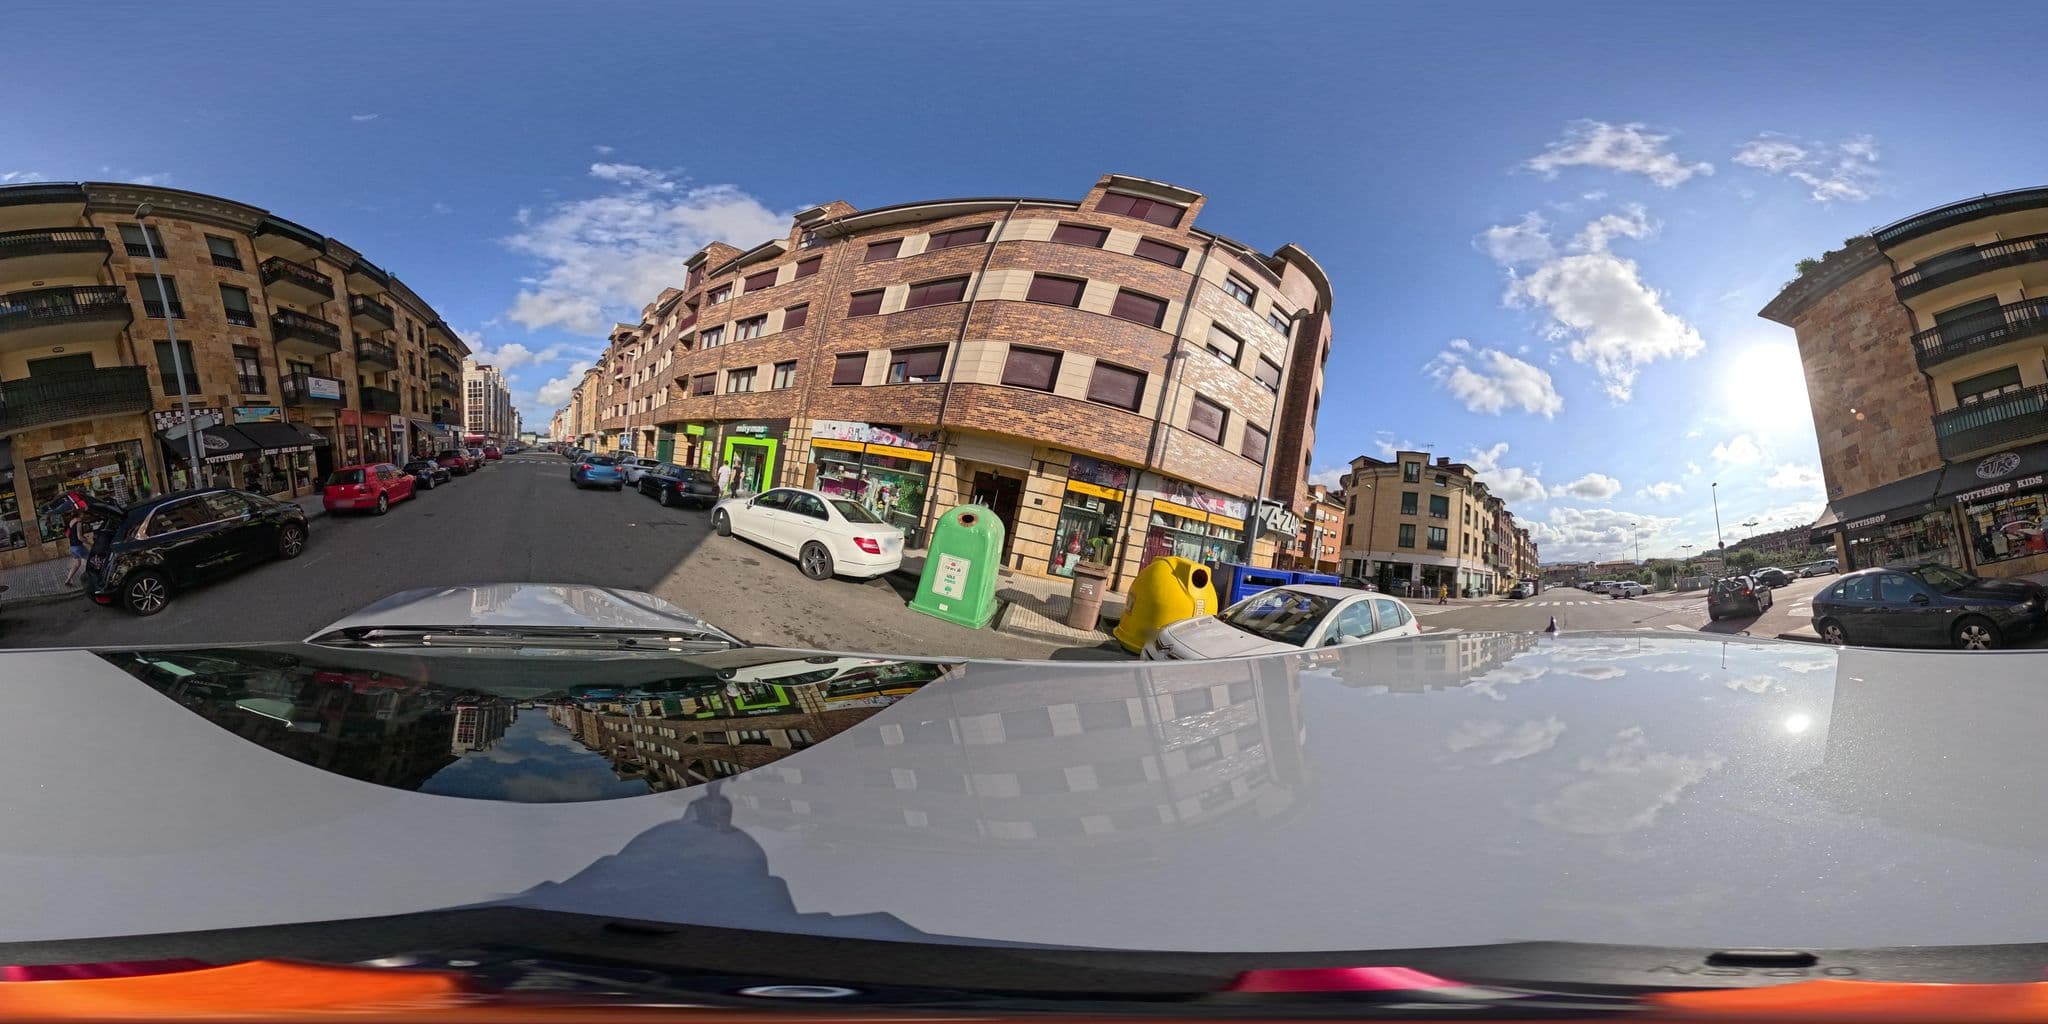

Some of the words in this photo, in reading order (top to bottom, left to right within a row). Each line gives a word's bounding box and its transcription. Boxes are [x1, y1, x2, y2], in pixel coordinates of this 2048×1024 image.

[205, 452, 244, 464] TOTTISHOP
[1956, 482, 2011, 503] TOTTISHOP
[2017, 475, 2043, 488] KIDS
[1846, 514, 1886, 530] TOTTISHOP
